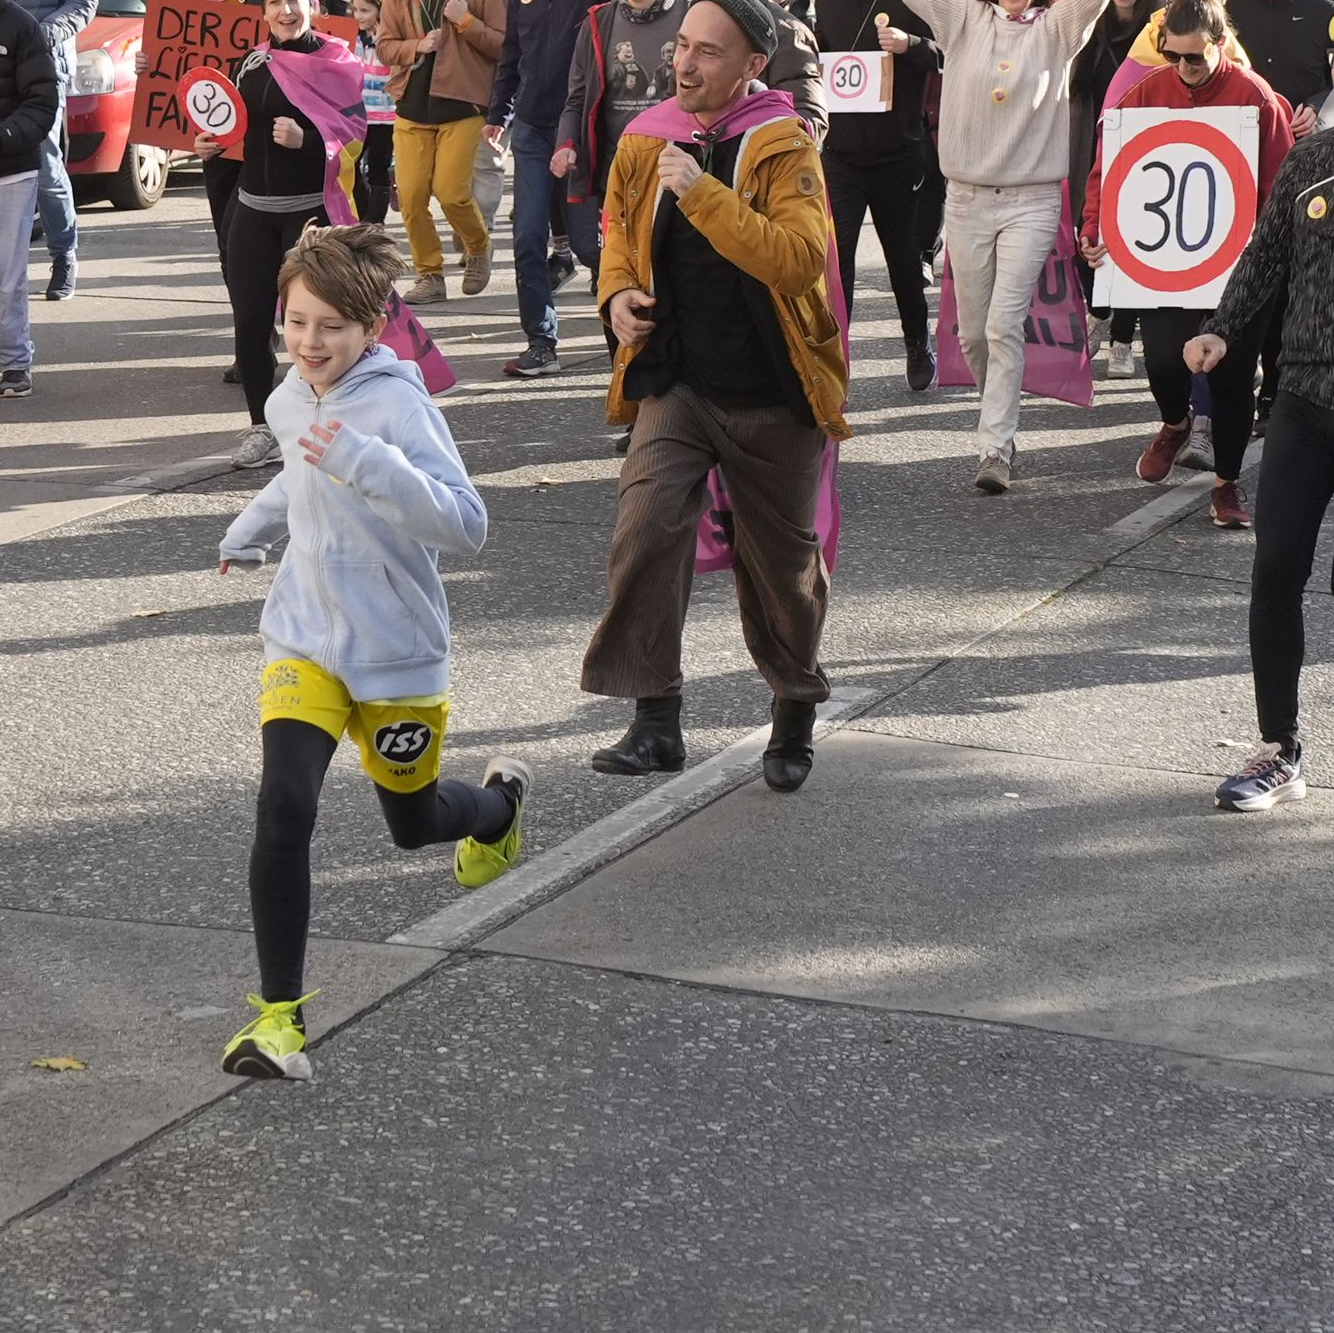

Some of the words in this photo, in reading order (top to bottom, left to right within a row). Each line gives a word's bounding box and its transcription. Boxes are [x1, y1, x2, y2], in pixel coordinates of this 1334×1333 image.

[157, 6, 221, 48] DER
[836, 64, 862, 88] 30
[193, 83, 232, 127] 30
[1134, 161, 1216, 252] 30
